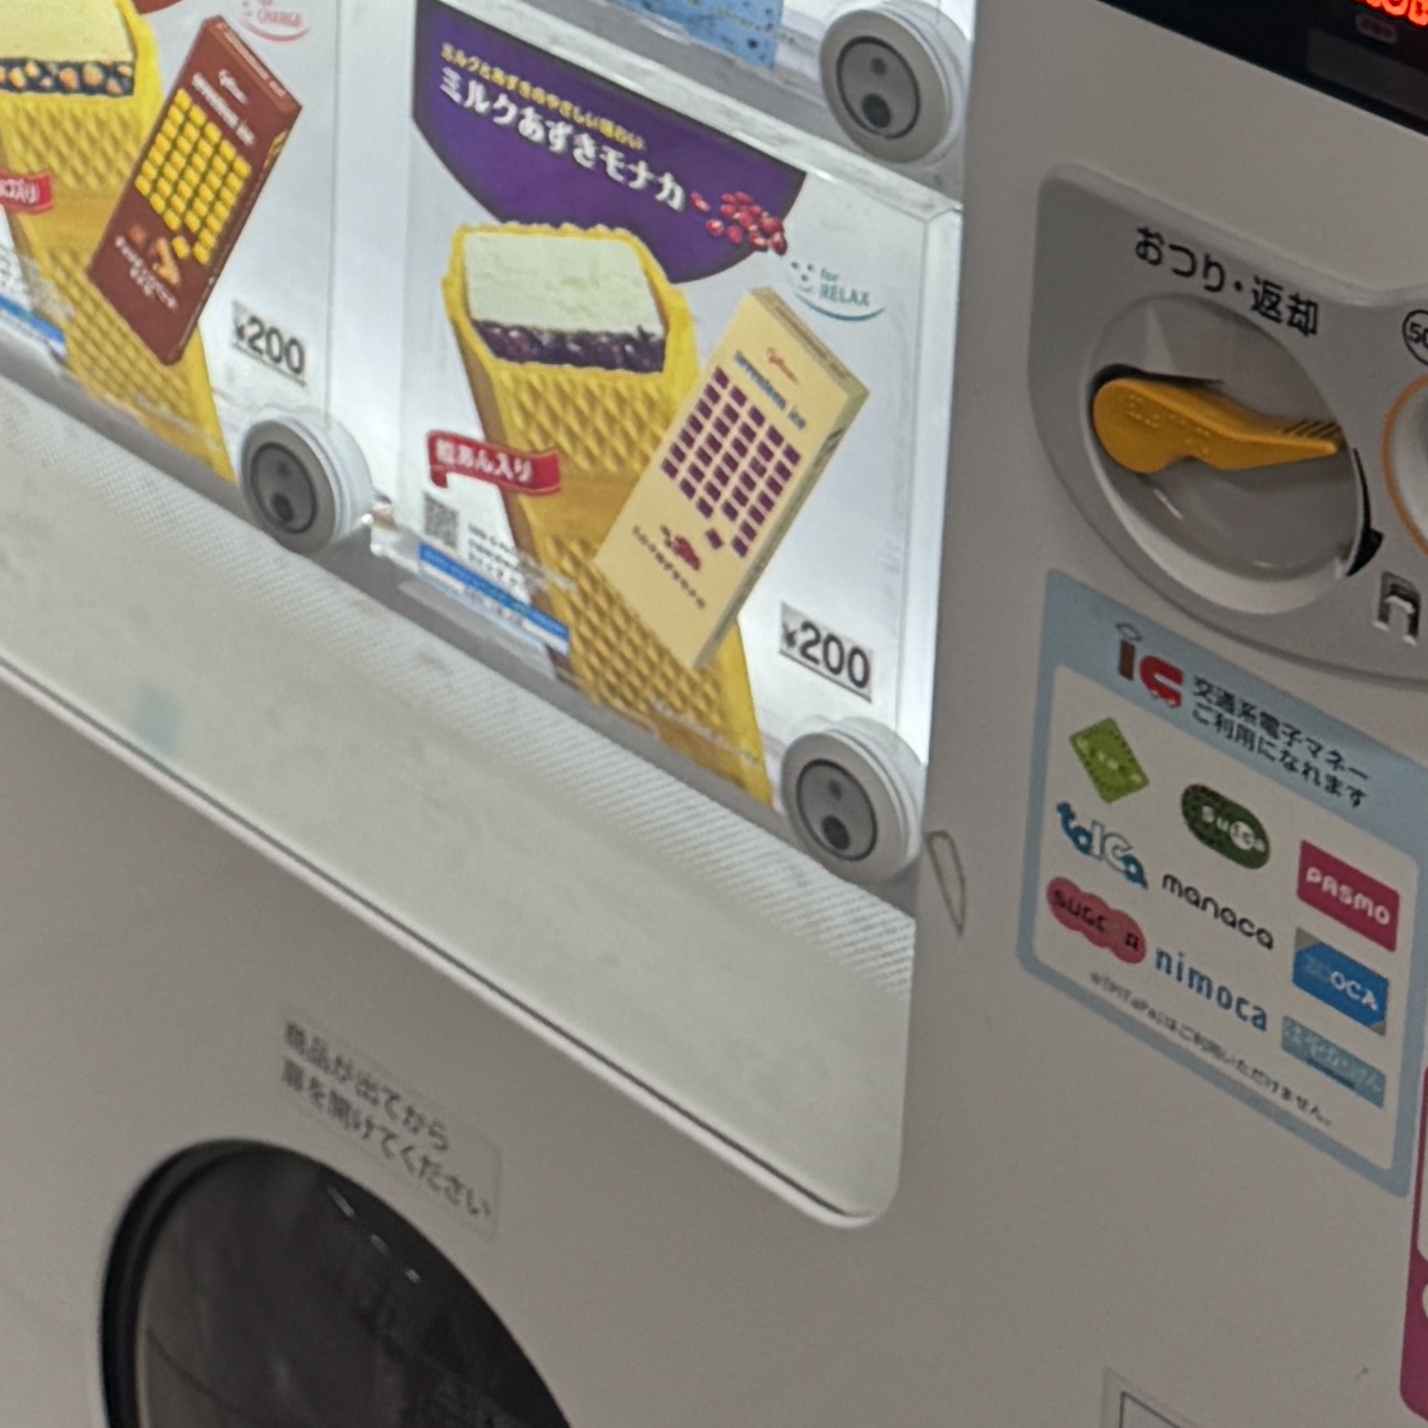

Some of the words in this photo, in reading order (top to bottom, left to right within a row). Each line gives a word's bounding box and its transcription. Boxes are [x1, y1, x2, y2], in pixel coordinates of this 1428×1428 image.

[439, 67, 686, 212] ミルクあずきモナカ
[819, 282, 871, 307] RELAX
[820, 267, 840, 283] for
[1134, 226, 1319, 338] おつり・返却
[235, 317, 306, 374] ¥200
[781, 622, 872, 689] ¥200
[1191, 703, 1369, 808] ご利用になれます
[1193, 675, 1371, 783] 交通系電子マネー
[1161, 873, 1275, 950] manaca
[1305, 867, 1391, 926] PASMO
[1155, 945, 1268, 1032] nimoca
